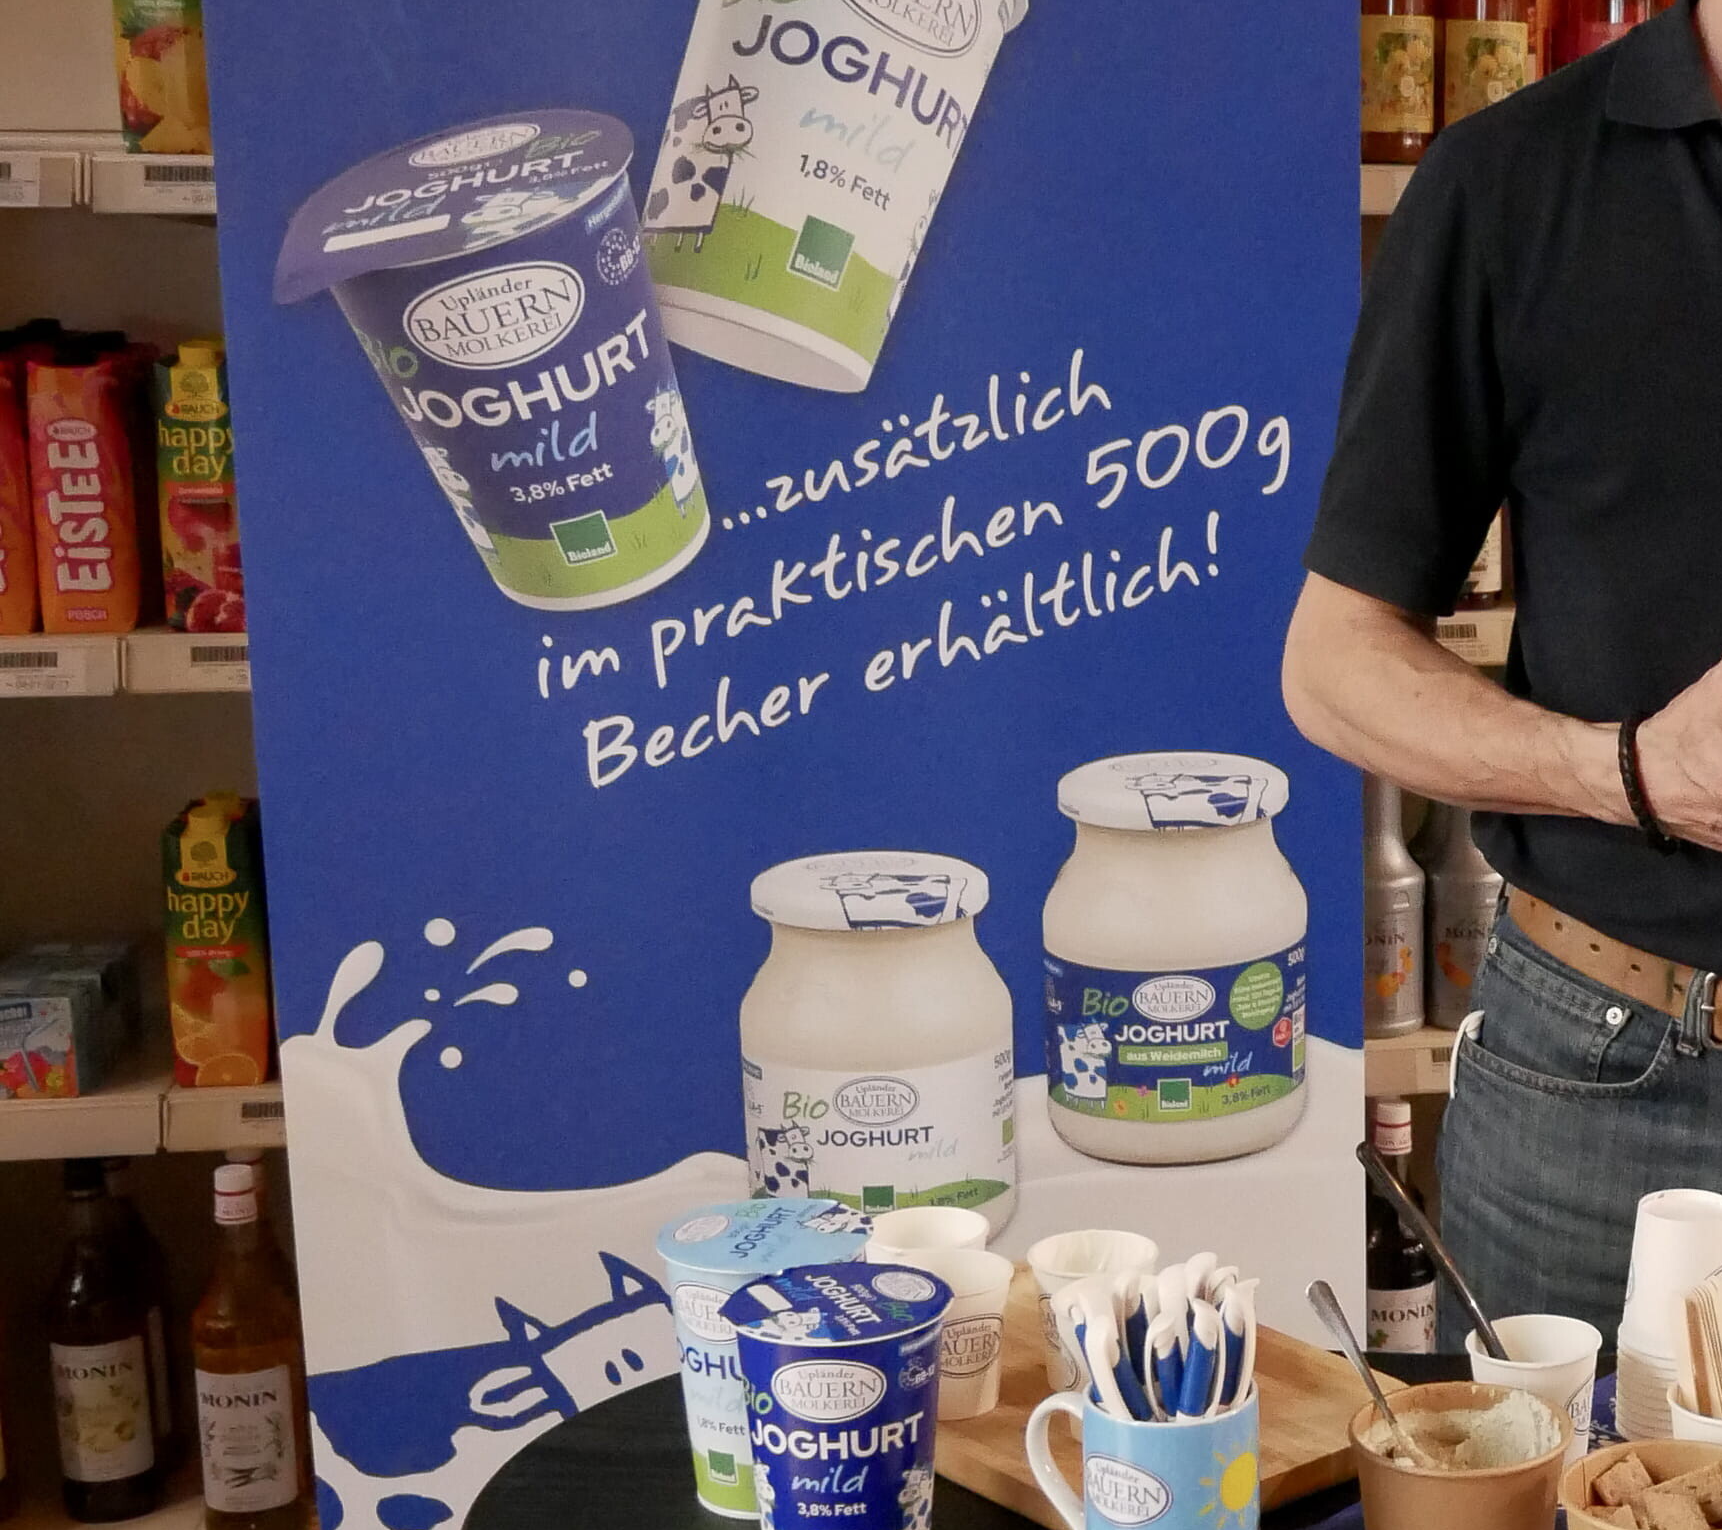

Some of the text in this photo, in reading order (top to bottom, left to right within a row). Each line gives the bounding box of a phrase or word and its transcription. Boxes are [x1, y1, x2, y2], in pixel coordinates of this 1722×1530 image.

[344, 150, 583, 214] JOGHURT
[850, 175, 891, 211] Fett
[440, 277, 532, 311] Upländer
[416, 278, 572, 342] BAUERN
[445, 312, 563, 358] MOLKEREI
[401, 309, 649, 428] JOGHURT
[491, 412, 599, 473] mild
[173, 452, 227, 482] day
[509, 462, 614, 504] 3,8% Fett
[536, 404, 1290, 699] im praktischen 500g
[581, 511, 1220, 787] Becher erhältlich!
[167, 886, 249, 920] happy
[182, 915, 235, 945] day
[1082, 988, 1129, 1017] Bio
[1139, 989, 1209, 1006] BAUERN
[1114, 1020, 1230, 1043] JOGHURT
[1126, 1047, 1222, 1062] aus Weidemilch
[1203, 1051, 1253, 1077] mild
[783, 1091, 829, 1119] Bio
[840, 1091, 913, 1109] BAUERN
[817, 1125, 934, 1147] JOGHURT
[730, 1207, 796, 1258] JOGHURT
[805, 1274, 882, 1324] JOGHURT
[1371, 1304, 1436, 1326] MONIN
[780, 1378, 877, 1399] BAUERN
[719, 1422, 745, 1435] Fett
[751, 1412, 923, 1460] JOGHURT
[792, 1464, 869, 1493] mild
[797, 1502, 866, 1517] 3,8% Fett
